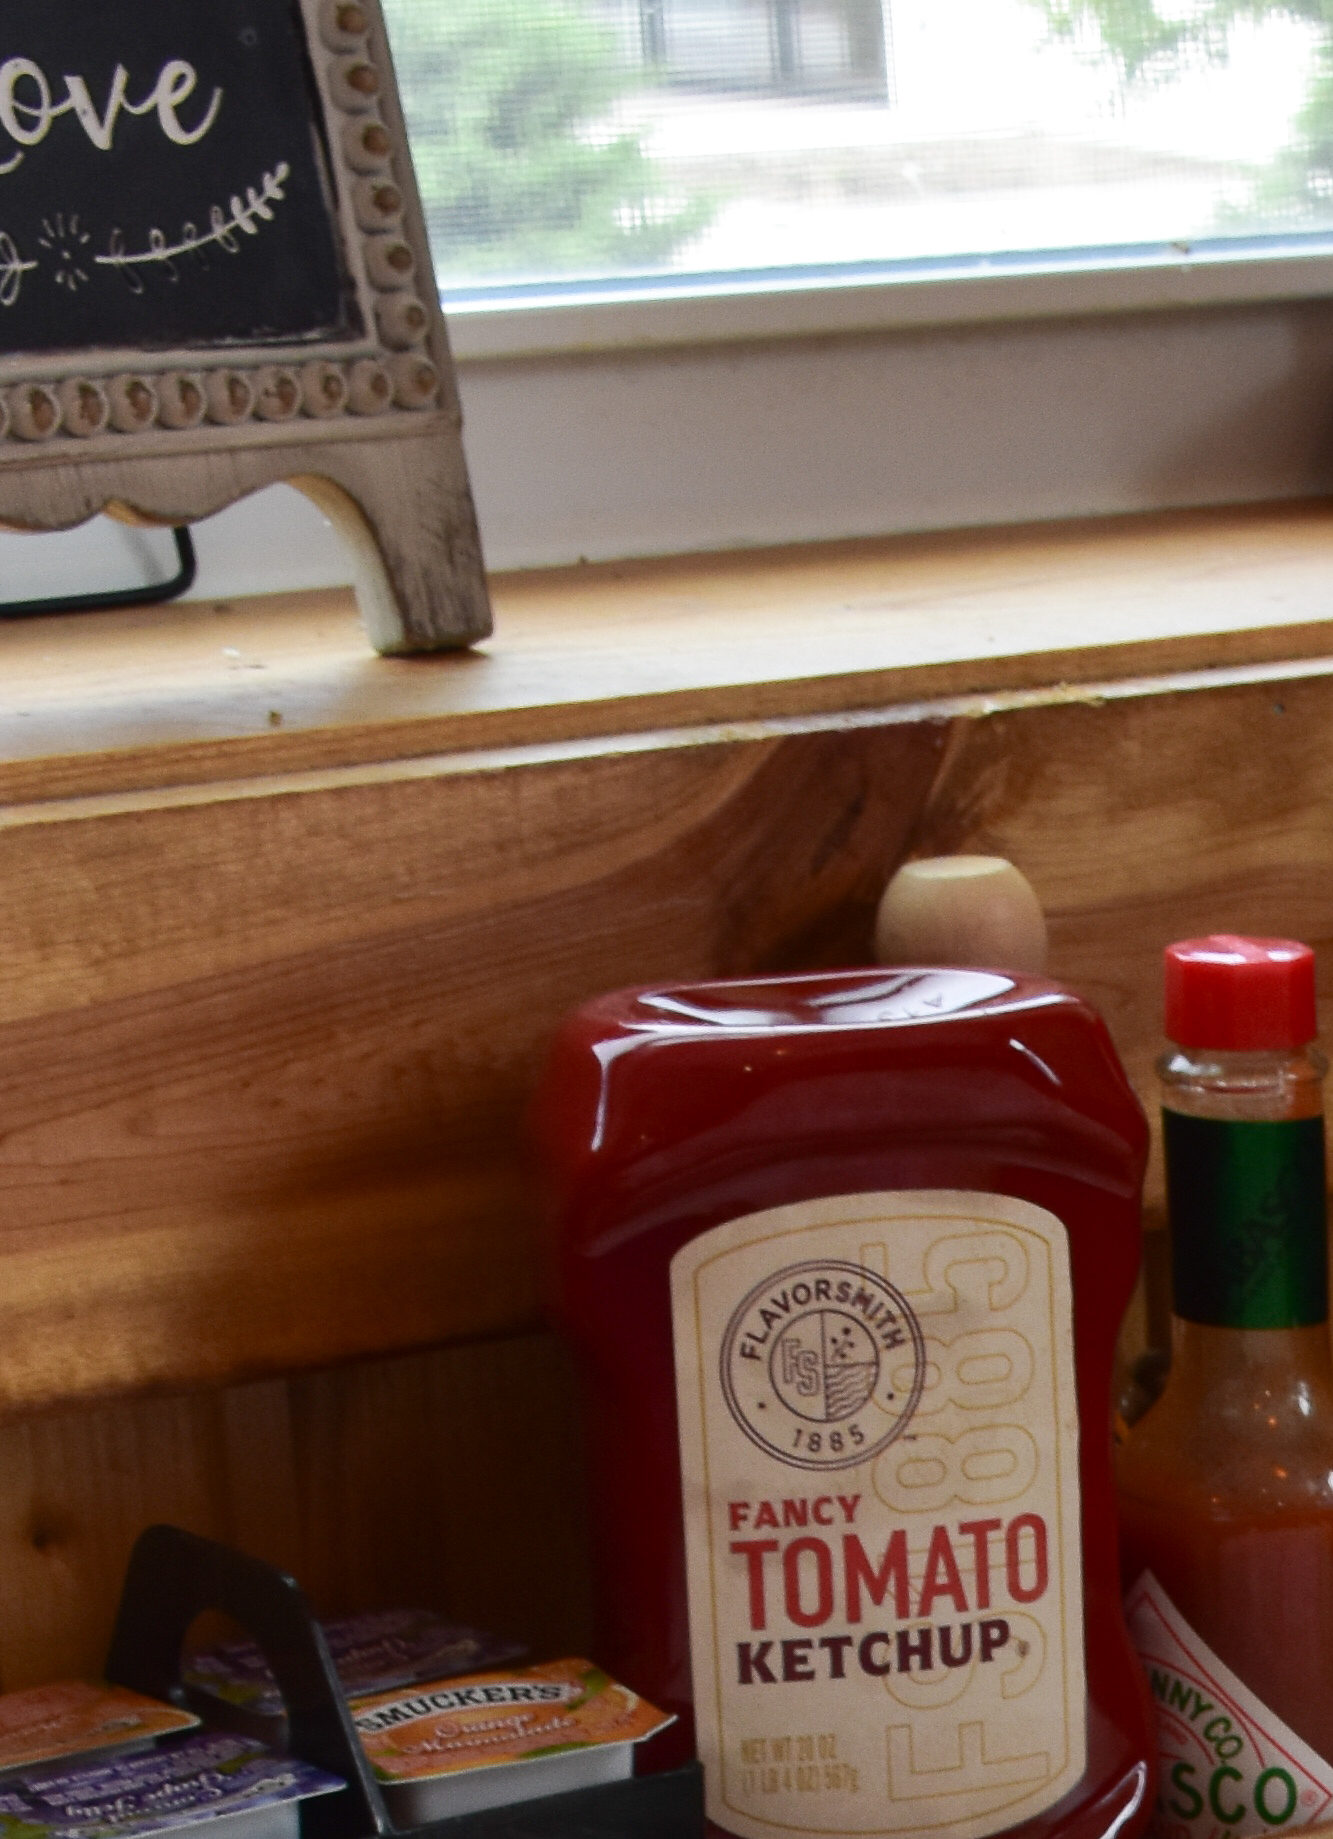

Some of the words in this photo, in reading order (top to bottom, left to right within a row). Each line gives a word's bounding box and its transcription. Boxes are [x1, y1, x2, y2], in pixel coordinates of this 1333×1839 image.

[0, 57, 223, 150] ove
[740, 1278, 906, 1363] FLAVORSMITH
[792, 1423, 866, 1453] 1885
[727, 1493, 862, 1532] FANCY
[729, 1511, 1050, 1632] TOMATO
[736, 1618, 1012, 1686] KETCHUP
[354, 1682, 561, 1731] SMUCKER'S
